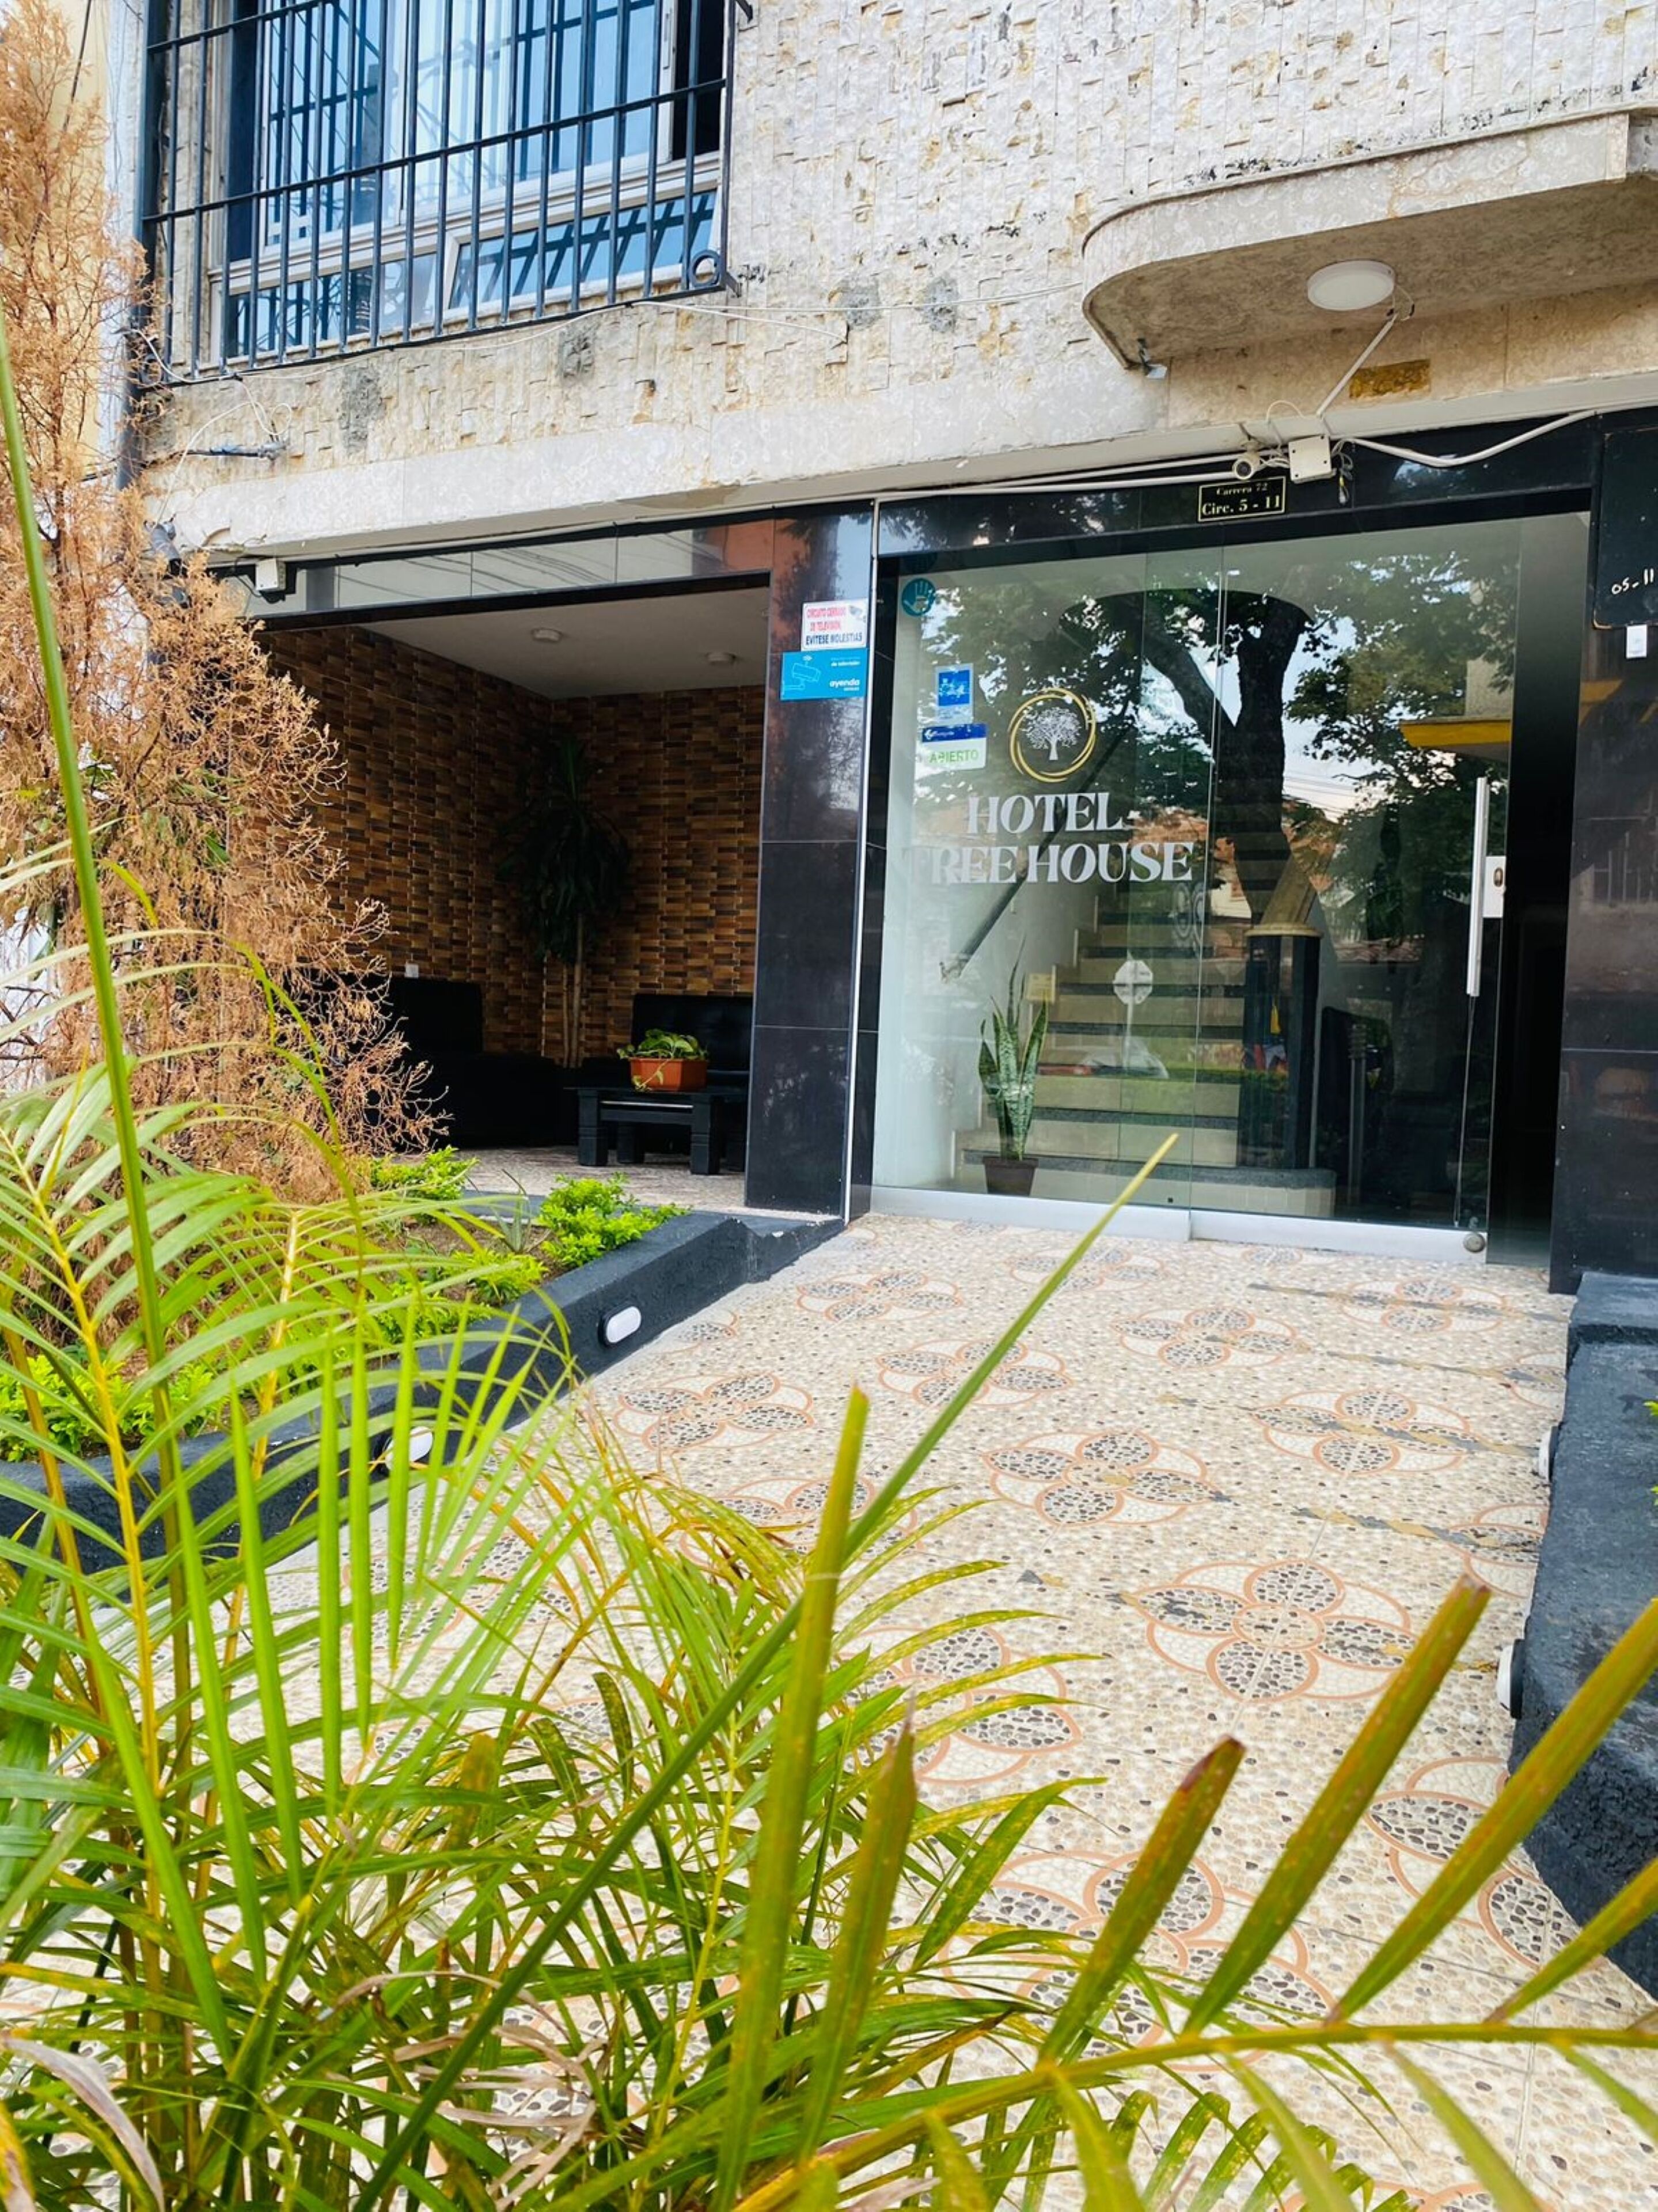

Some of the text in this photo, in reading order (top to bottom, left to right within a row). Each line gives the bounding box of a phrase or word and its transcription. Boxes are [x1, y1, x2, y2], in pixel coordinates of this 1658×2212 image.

[1202, 502, 1234, 516] Circ.
[1239, 498, 1248, 512] 5
[1266, 495, 1280, 509] 11
[830, 632, 862, 643] MOLESTIAS
[830, 678, 860, 689] ayenda
[929, 749, 978, 764] ABIERTO
[969, 792, 1124, 834] HOTEL
[1026, 842, 1194, 883] HOUSE
